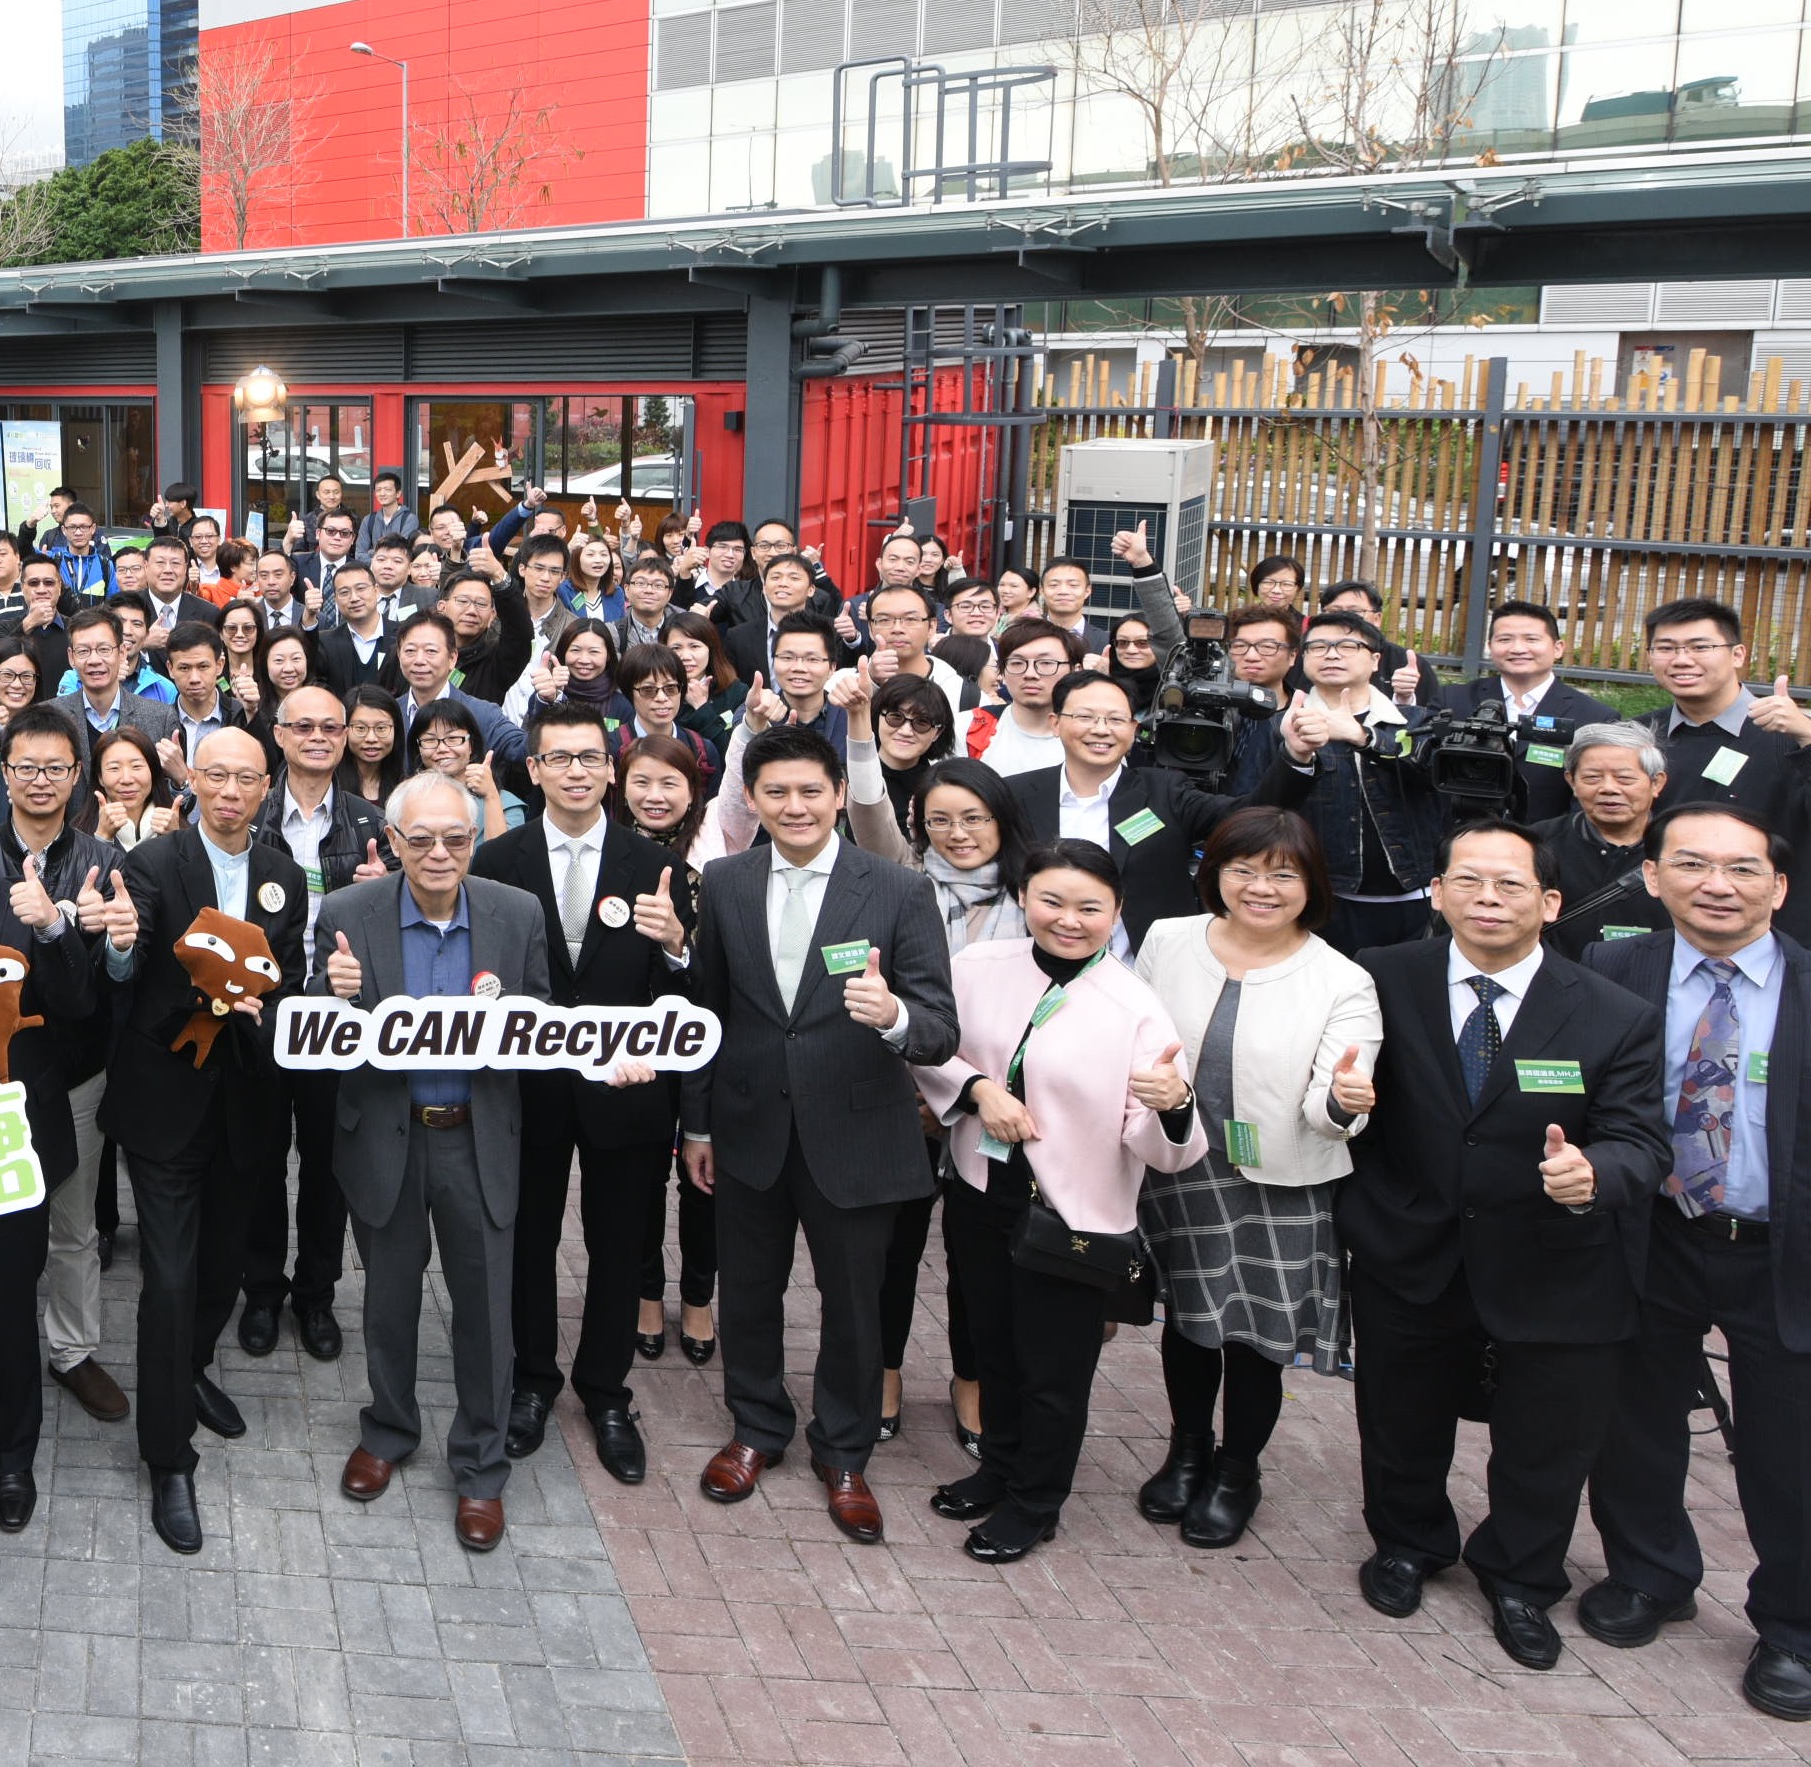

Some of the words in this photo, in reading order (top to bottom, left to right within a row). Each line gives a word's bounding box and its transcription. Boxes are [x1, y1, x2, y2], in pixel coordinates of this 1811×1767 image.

[287, 1010, 362, 1056] We
[377, 1010, 487, 1056] CAN
[497, 1010, 706, 1067] Recycle
